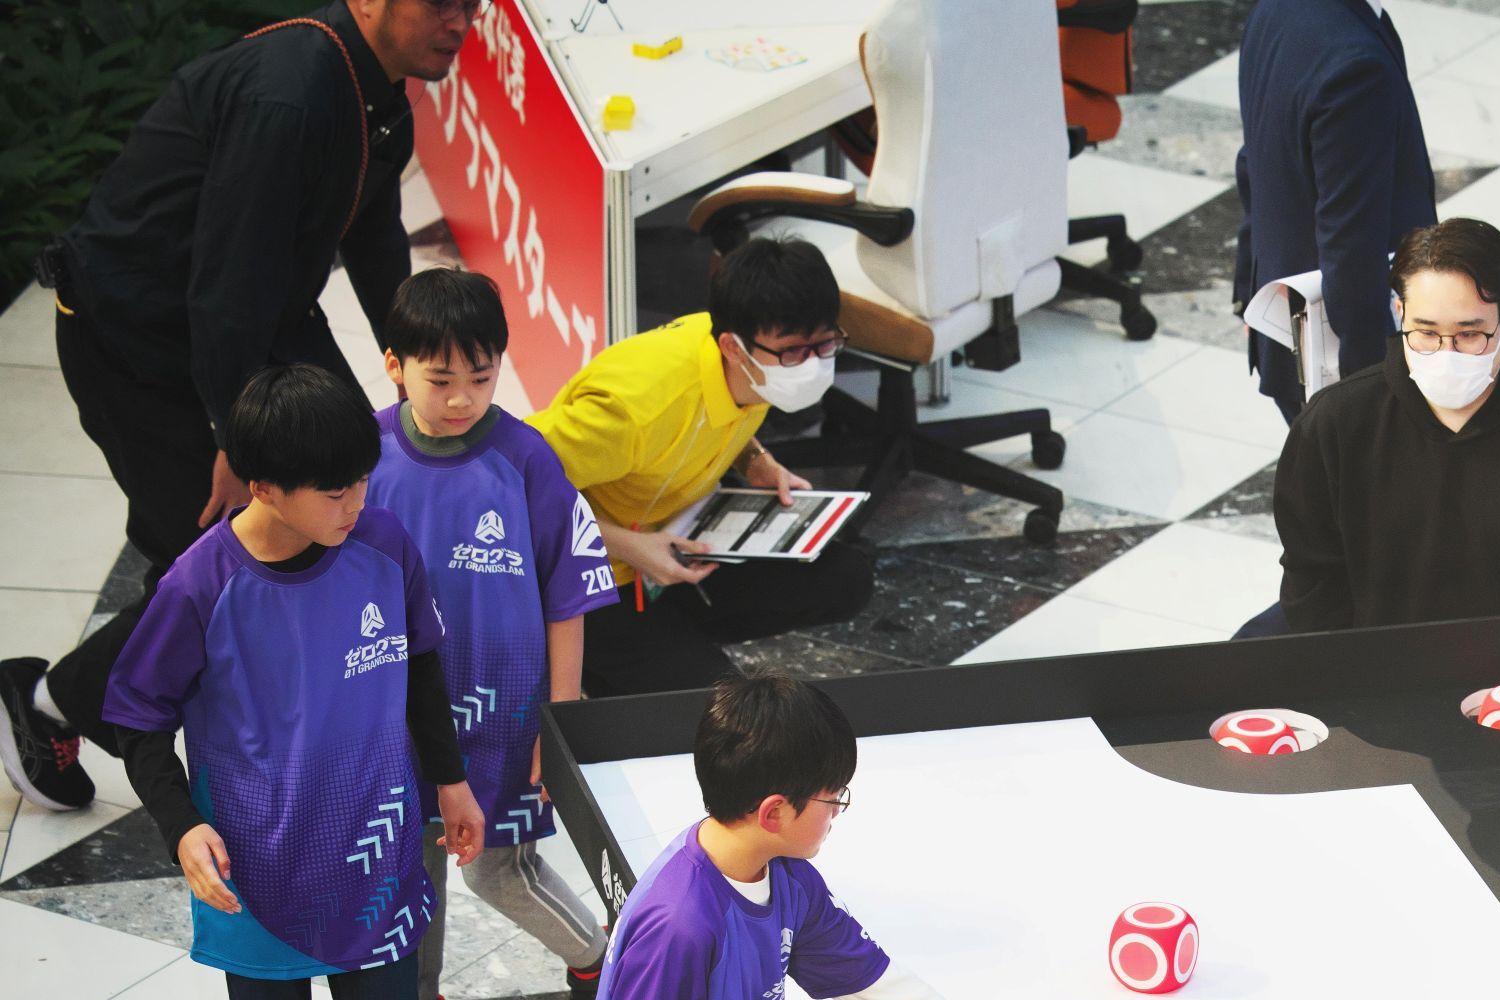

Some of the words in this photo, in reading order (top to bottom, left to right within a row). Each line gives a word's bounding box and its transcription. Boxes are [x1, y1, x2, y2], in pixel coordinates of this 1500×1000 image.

[453, 543, 523, 567] ゼログラ
[465, 560, 525, 577] GRANDSLAM
[581, 565, 617, 596] 20
[345, 635, 408, 668] ゼログラ
